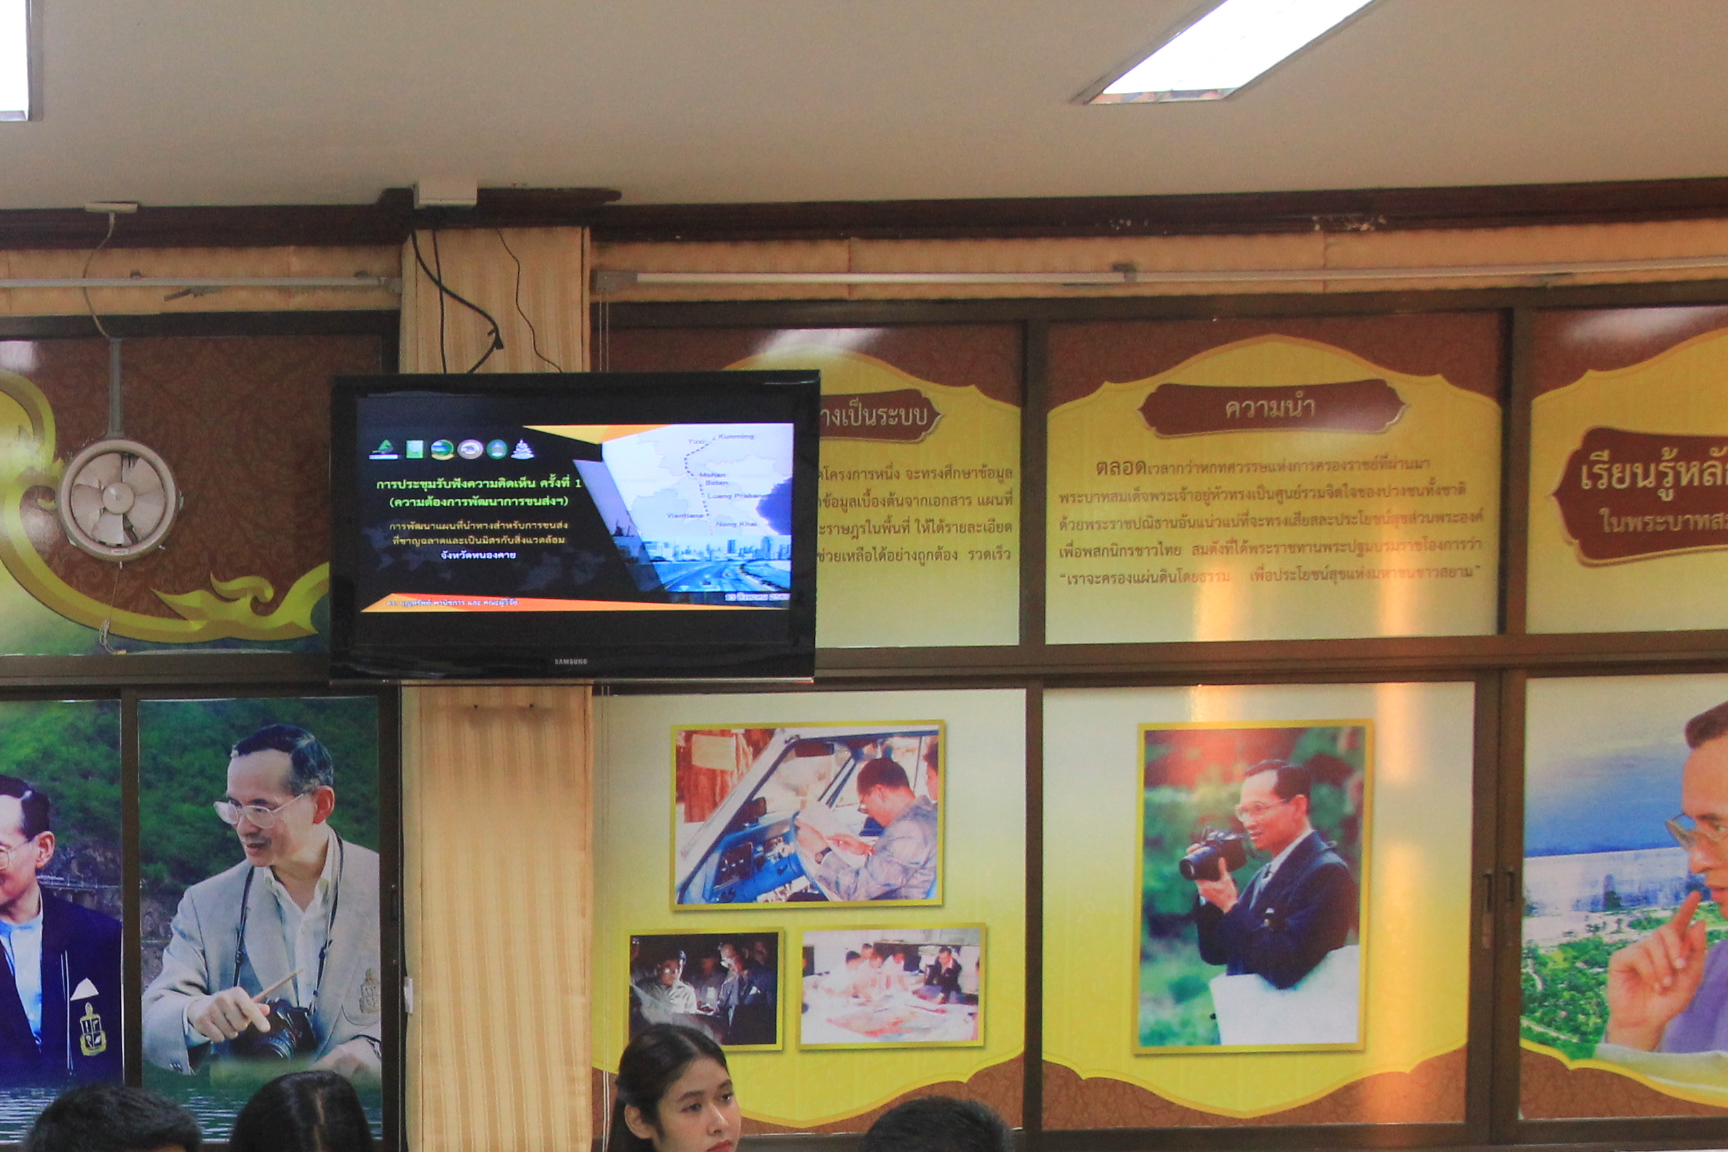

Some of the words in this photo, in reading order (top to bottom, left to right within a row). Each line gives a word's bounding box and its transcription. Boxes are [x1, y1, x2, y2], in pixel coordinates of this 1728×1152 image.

[1225, 390, 1316, 419] ความนำ
[376, 476, 536, 492] การประชุมรับฟังความคิดเห็น
[540, 473, 571, 489] ครั้งที่
[575, 479, 582, 488] 1
[905, 463, 1013, 484] จะทรงศึกษาข้อมูล
[1581, 446, 1728, 501] เรียนรู้หลั
[818, 488, 972, 513] ข้อมูลเบื้องต้นจากเอกสาร
[977, 491, 1013, 507] แผนที่
[915, 518, 1013, 535] ให้ได้รายละเอียด
[1598, 507, 1728, 533] ในพระบาทส
[440, 551, 517, 560] จังหวัดหนองคาย
[968, 544, 1011, 561] รวดเร็ว
[1059, 540, 1182, 558] เพื่อพสกนิกรชาวไทย
